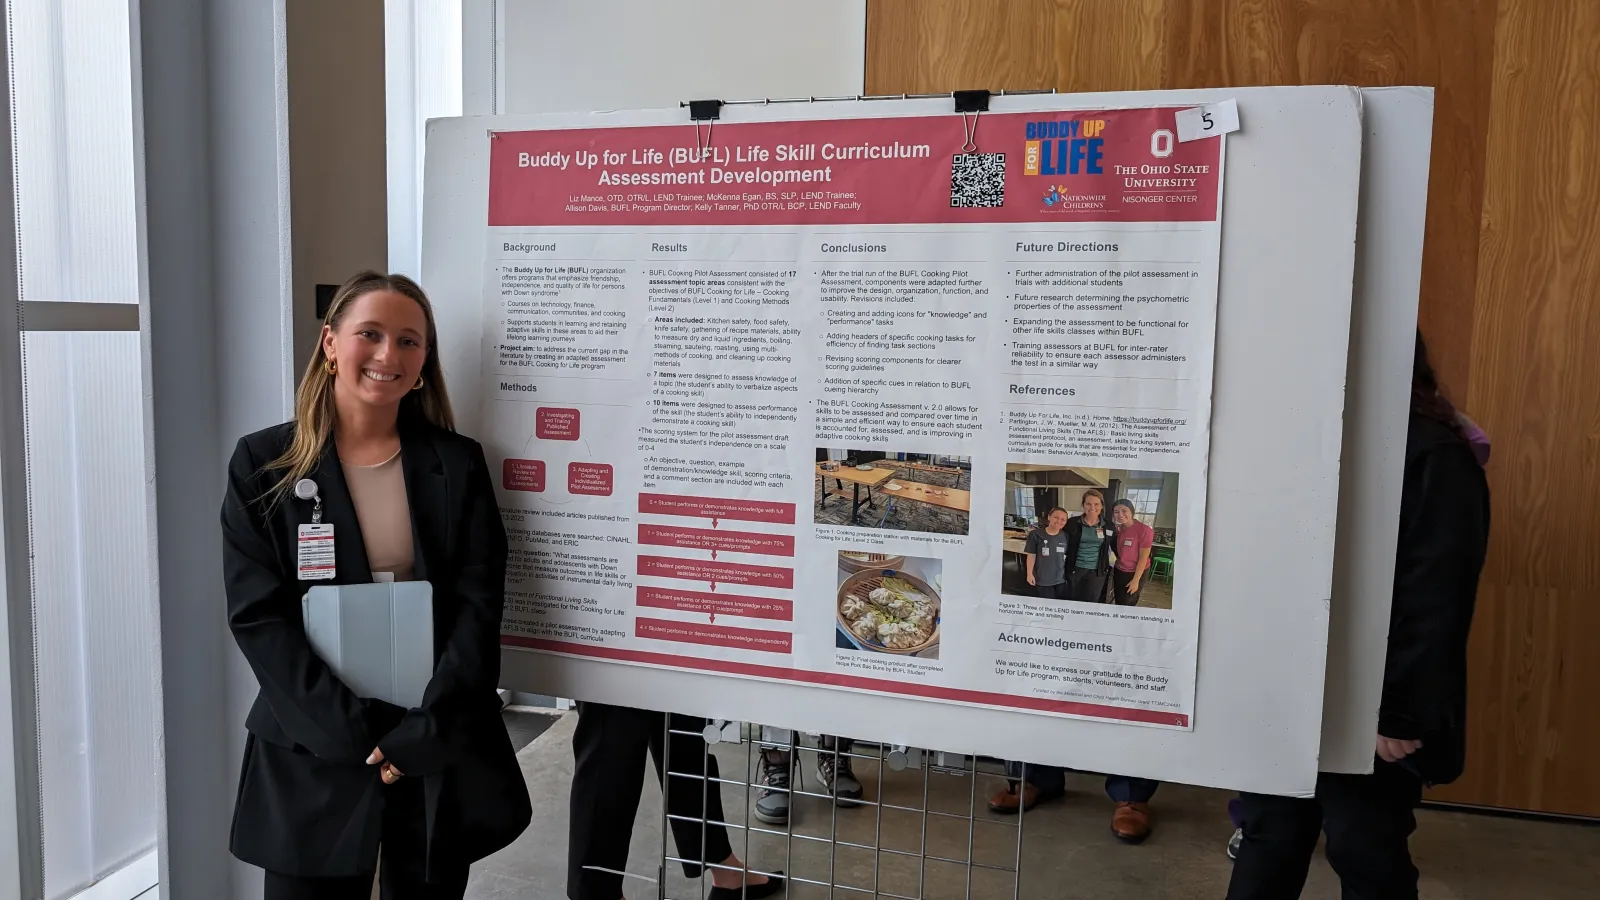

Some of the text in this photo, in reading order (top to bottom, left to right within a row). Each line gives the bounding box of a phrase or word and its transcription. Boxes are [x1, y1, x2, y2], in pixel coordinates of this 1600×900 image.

[1202, 113, 1214, 130] 5
[1026, 120, 1104, 138] BUDDY UP
[1151, 129, 1174, 158] O
[518, 141, 930, 170] Buddy Up for Life (BUFL) Life Skill Curriculum
[1027, 147, 1037, 170] FOR
[1040, 138, 1103, 175] LIFE
[1114, 164, 1209, 174] THE OHIO STATE
[598, 166, 831, 186] Assessment Development
[1124, 177, 1196, 187] UNIVERSITY
[742, 192, 763, 202] Egan,
[780, 192, 798, 200] SLP,
[632, 203, 662, 212] Program
[694, 203, 712, 212] Kelly
[714, 203, 741, 211] Tanner,
[787, 202, 806, 210] BCP,
[834, 201, 861, 210] Faculty
[503, 242, 556, 253] Background
[651, 243, 687, 252] Results
[821, 243, 886, 252] Conclusions
[1016, 241, 1118, 251] Future Directions
[920, 270, 950, 278] Cooking
[1123, 270, 1140, 278] pilot
[1075, 294, 1120, 303] determining
[1136, 295, 1189, 303] psychometric
[667, 304, 674, 312] 2)
[1013, 317, 1052, 326] Expanding
[1011, 341, 1041, 350] Training
[500, 382, 537, 392] Methods
[1009, 384, 1075, 395] References
[844, 434, 870, 442] cooking
[998, 632, 1112, 652] Acknowledgements
[1145, 674, 1168, 684] Buddy
